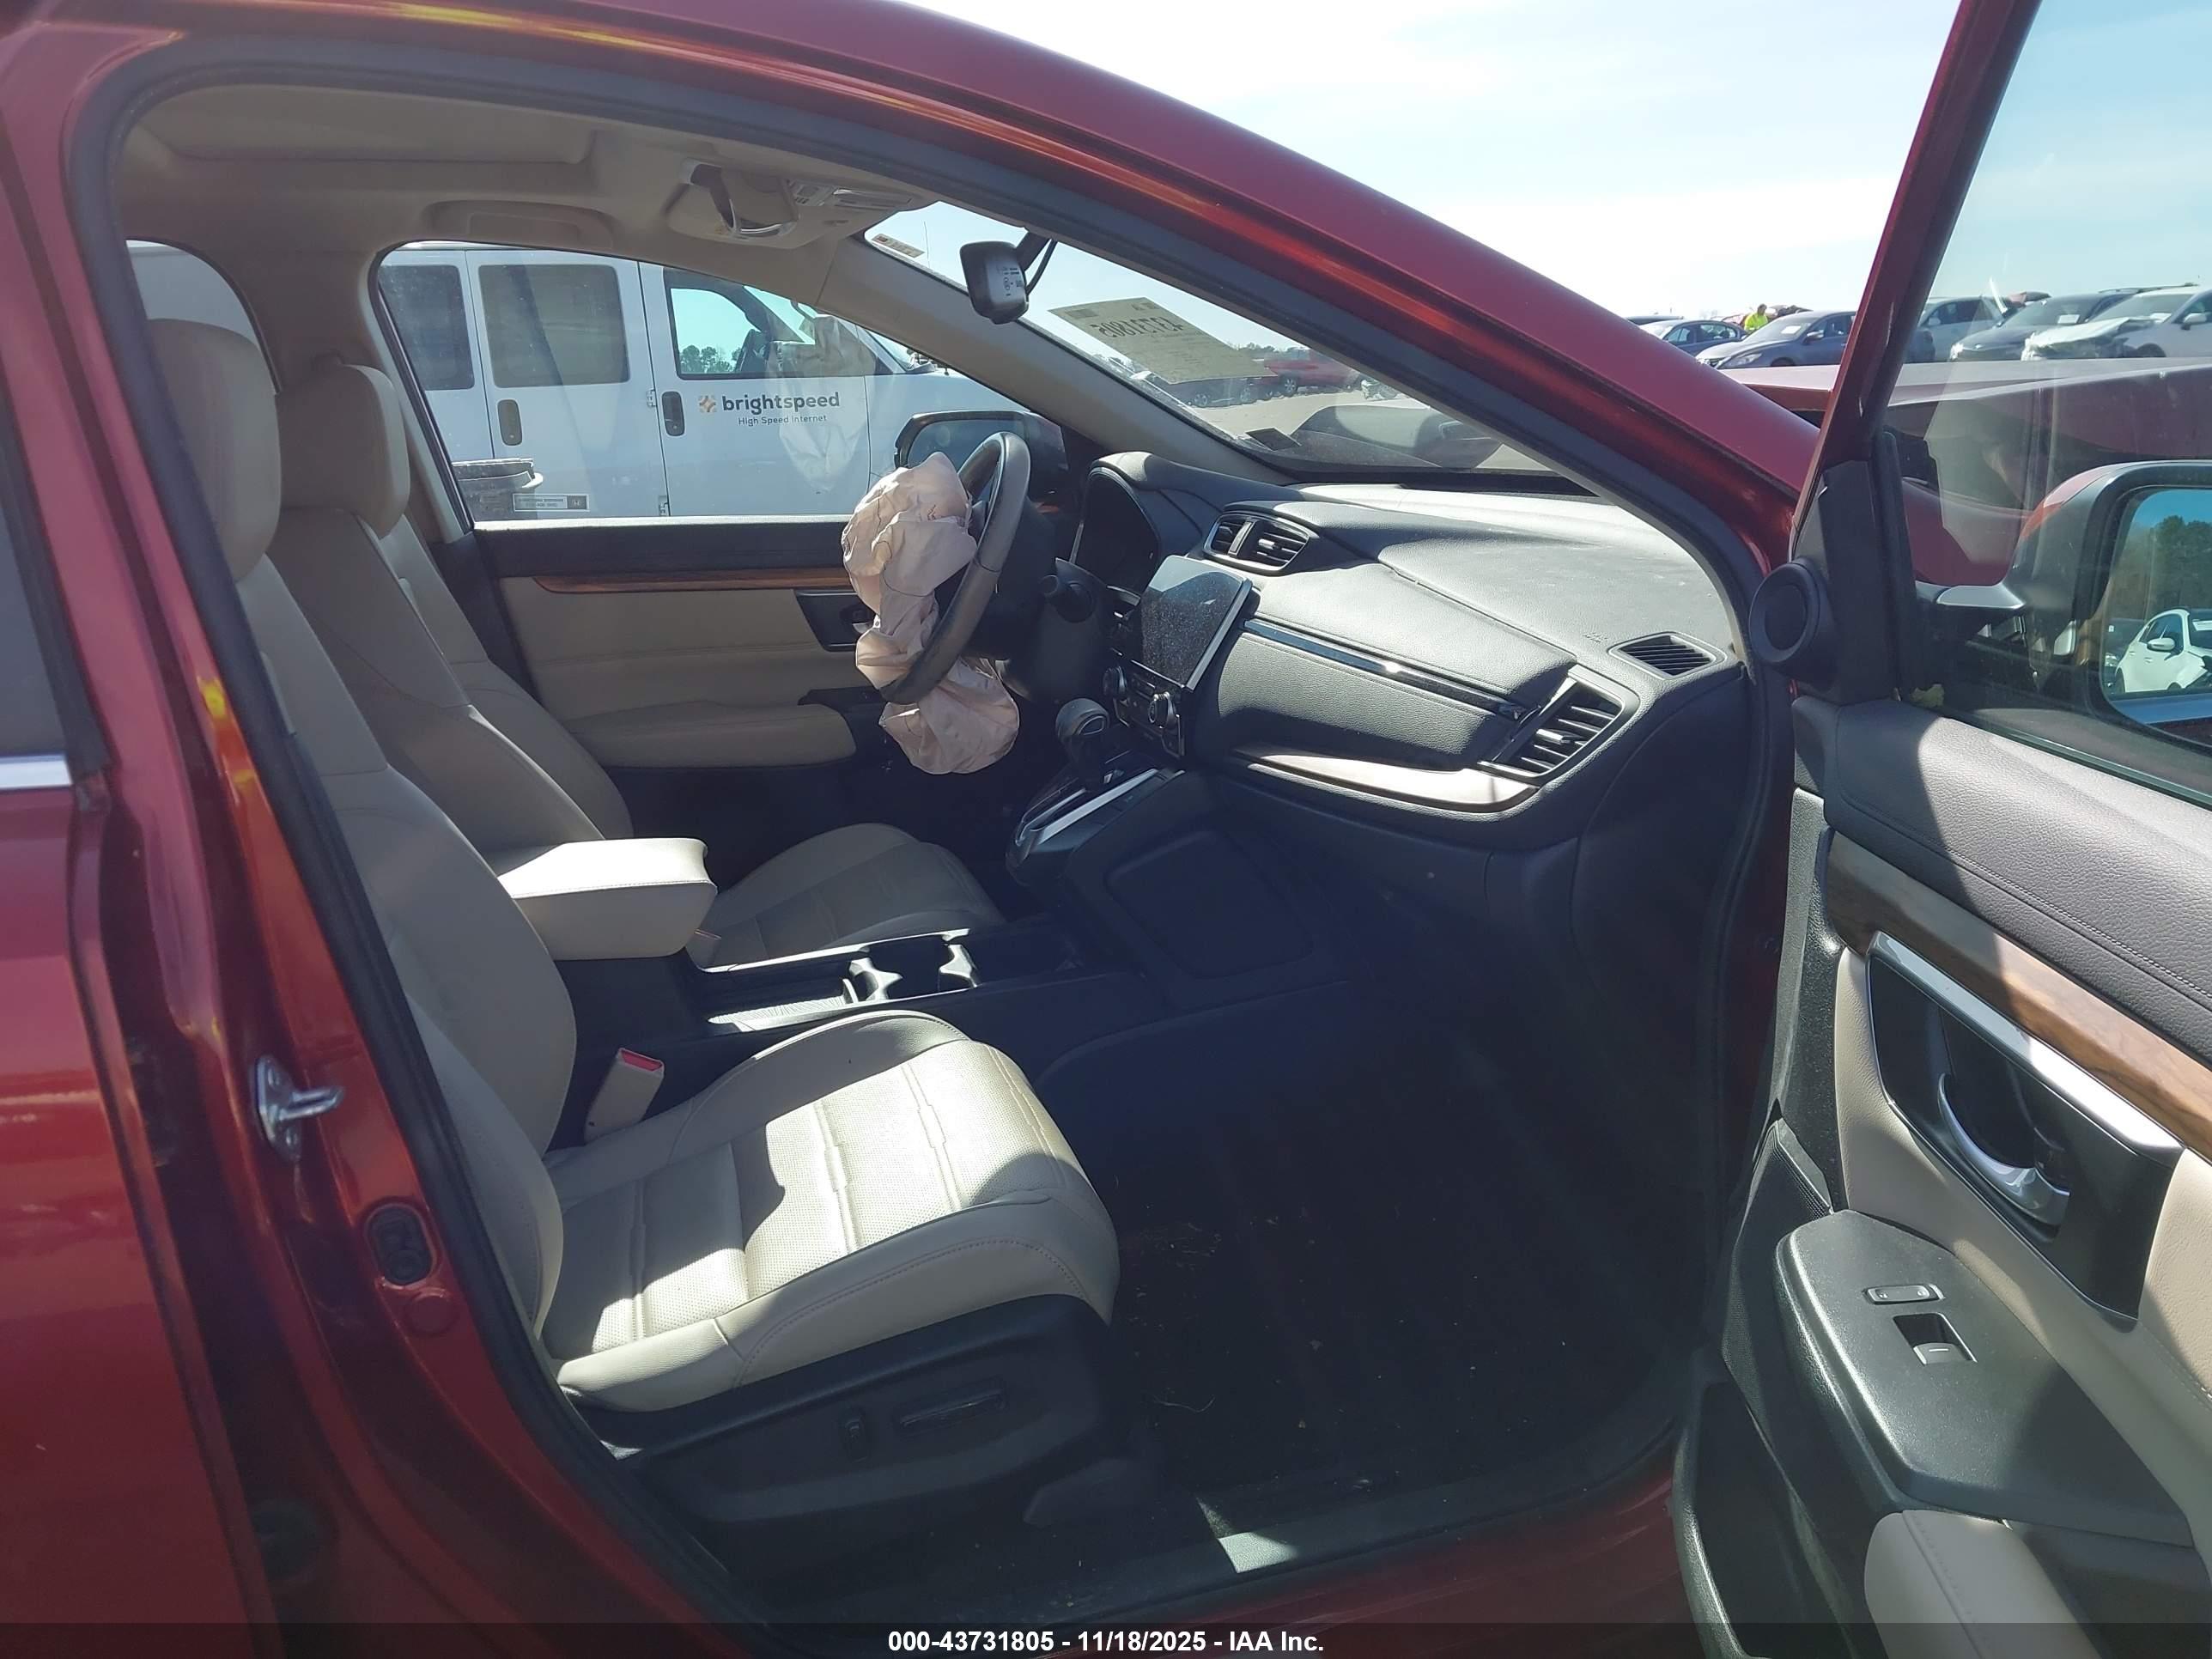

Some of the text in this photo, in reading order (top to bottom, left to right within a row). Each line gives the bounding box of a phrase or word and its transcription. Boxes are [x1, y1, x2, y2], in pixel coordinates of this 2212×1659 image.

[721, 392, 841, 416] brightspeed
[738, 416, 759, 427] High
[761, 416, 789, 425] Speed
